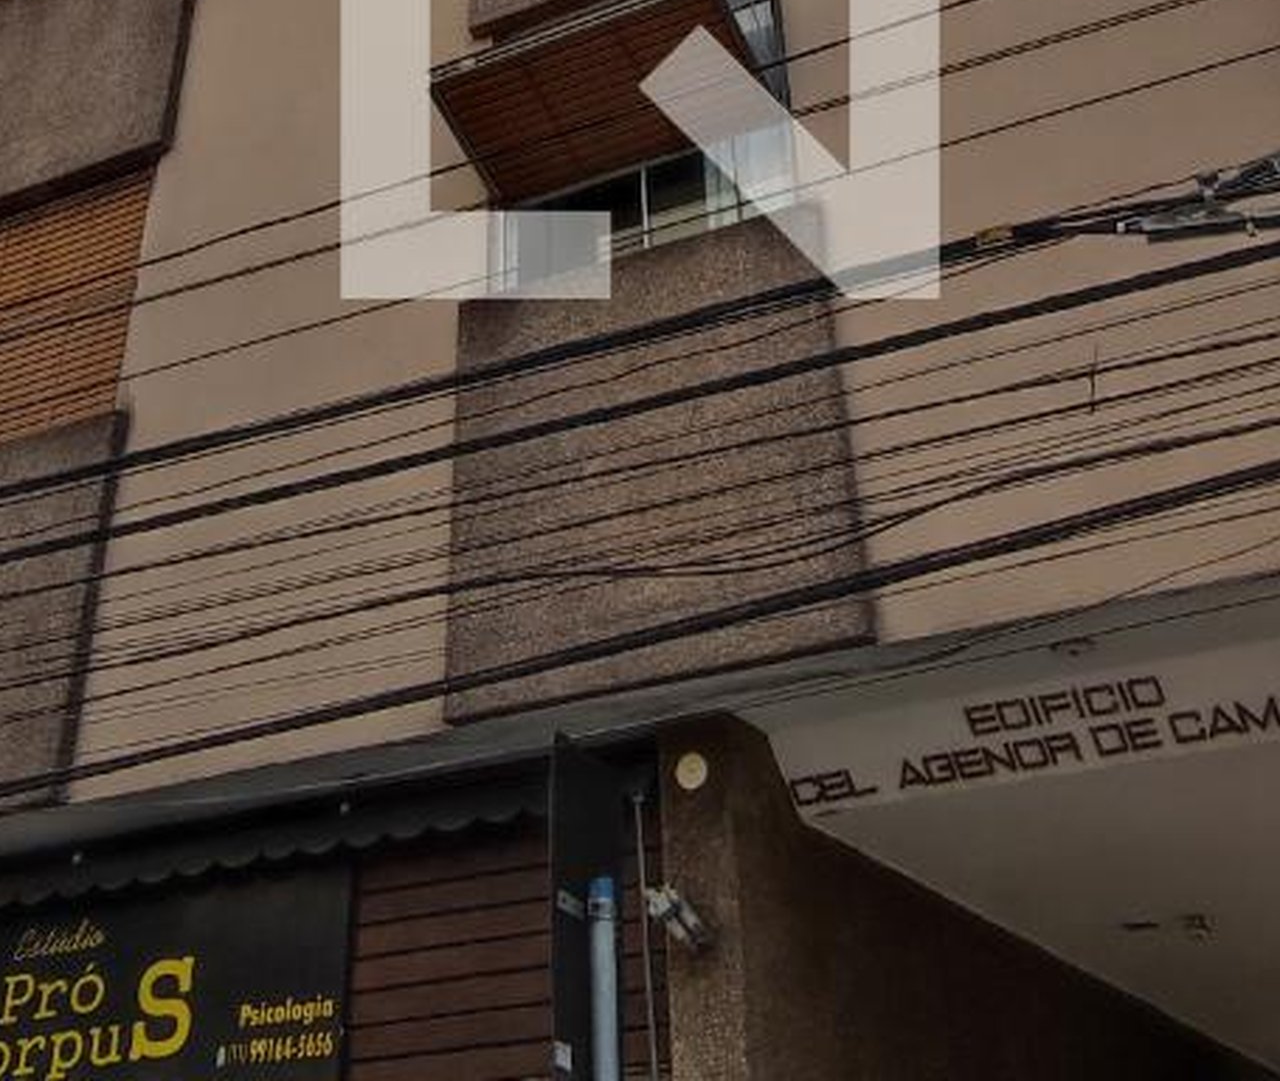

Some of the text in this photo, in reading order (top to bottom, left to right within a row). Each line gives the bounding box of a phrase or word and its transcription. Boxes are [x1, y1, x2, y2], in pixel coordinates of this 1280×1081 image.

[789, 769, 878, 806] CEL
[899, 731, 1083, 789] AGENOR
[1089, 717, 1163, 757] DE
[238, 993, 335, 1029] Psicologia
